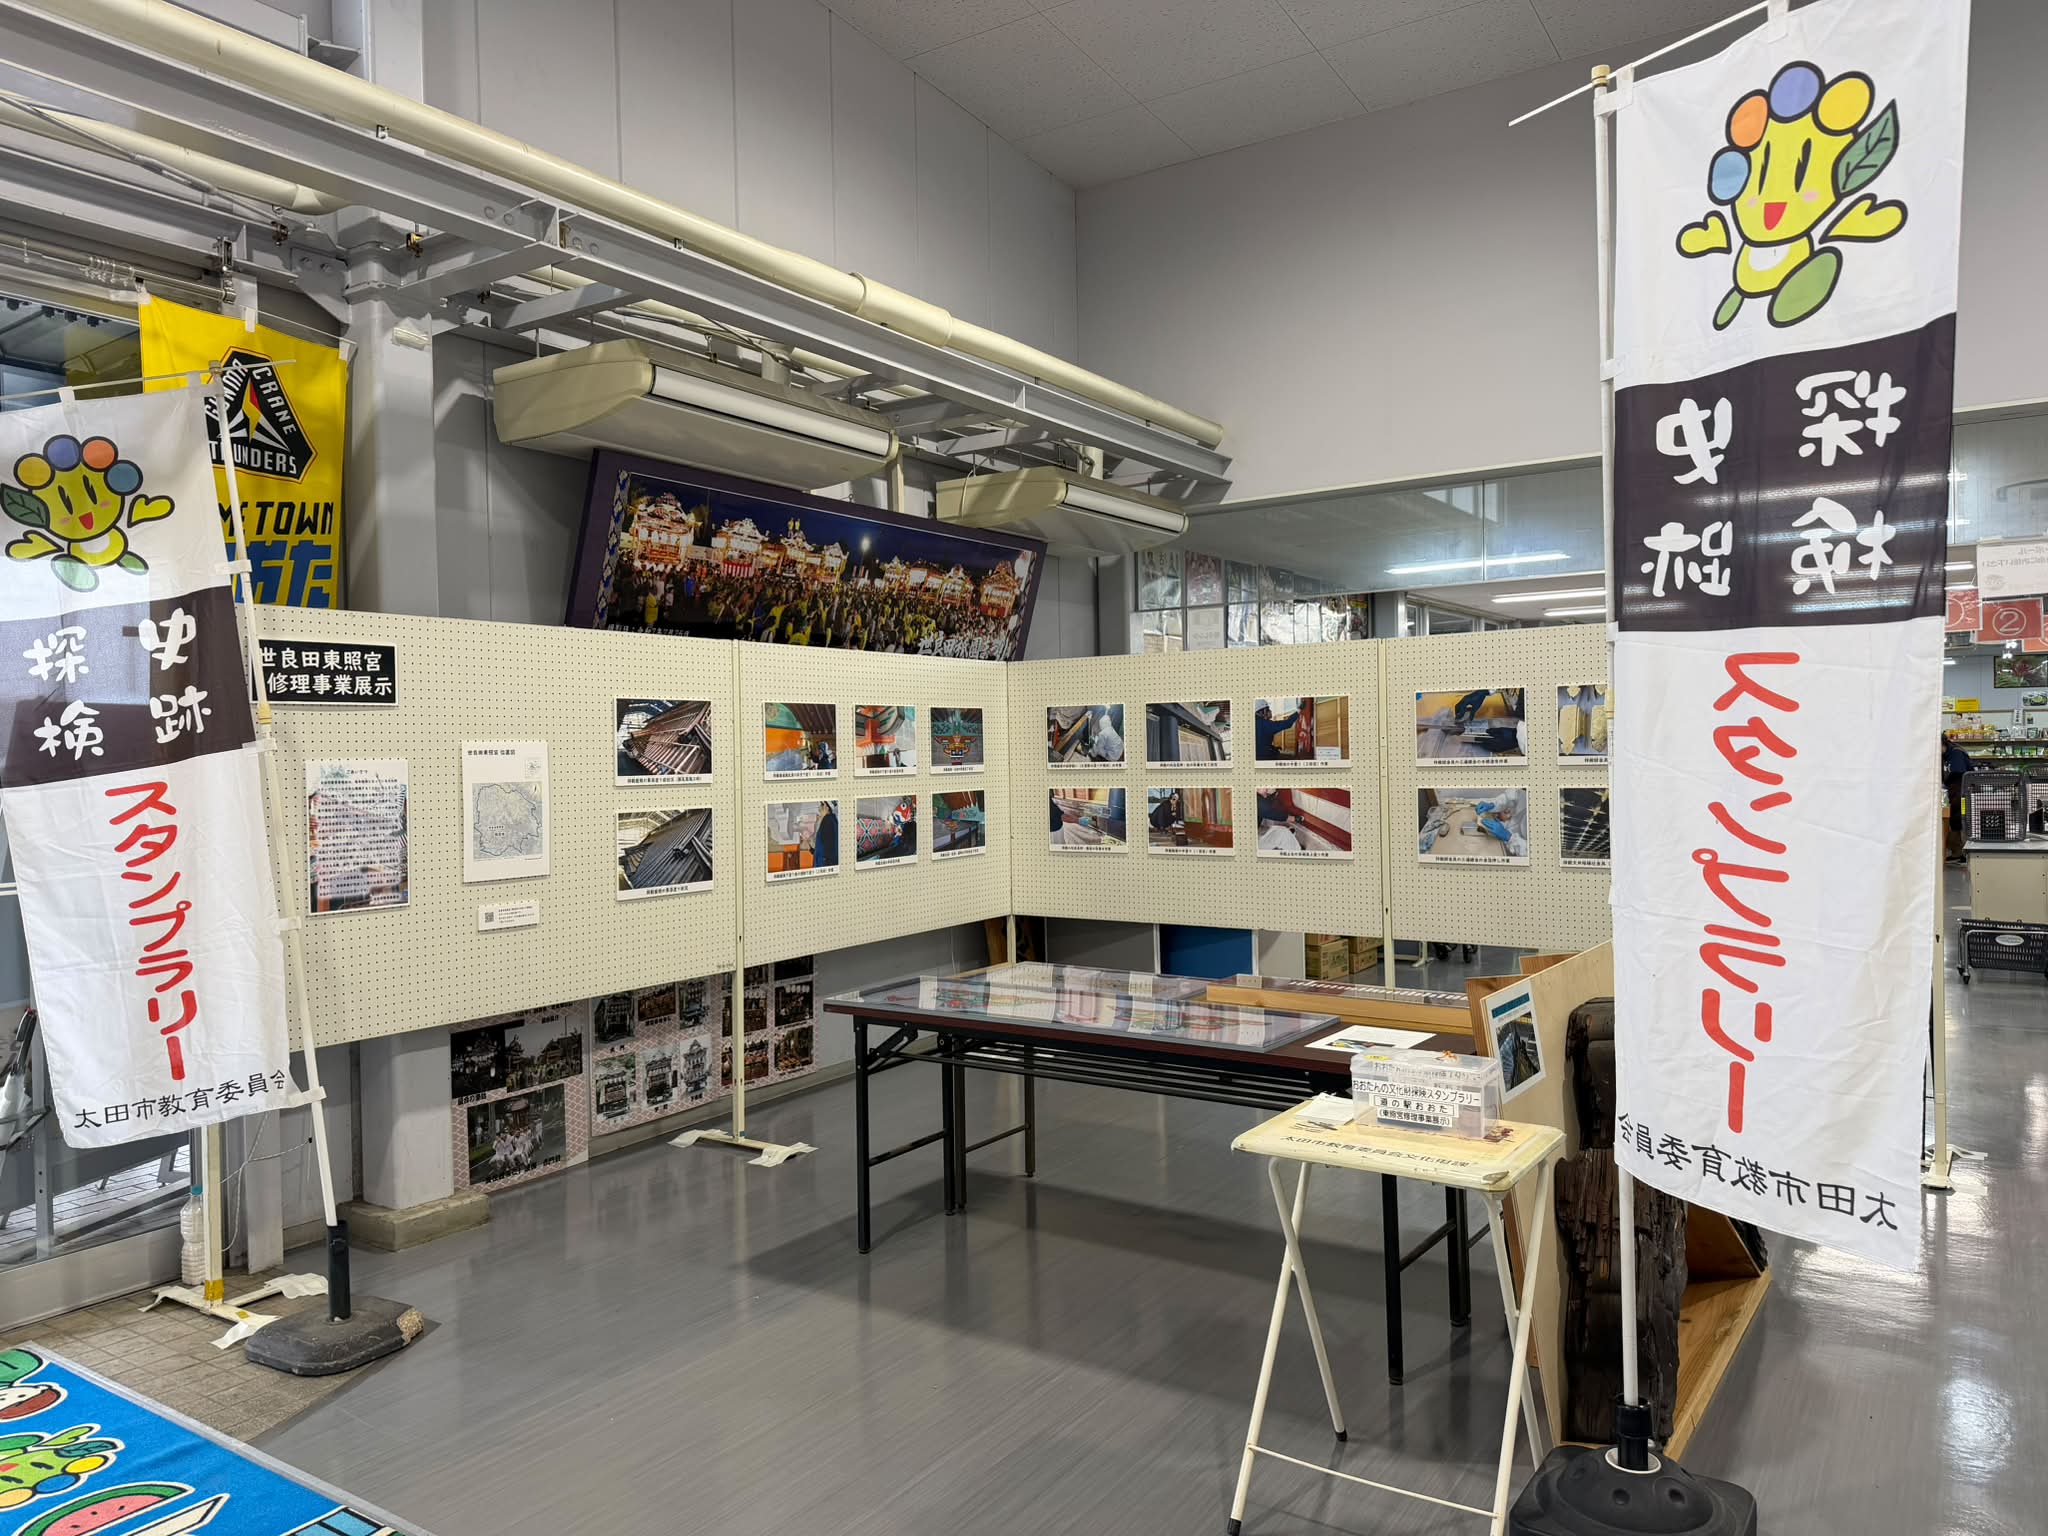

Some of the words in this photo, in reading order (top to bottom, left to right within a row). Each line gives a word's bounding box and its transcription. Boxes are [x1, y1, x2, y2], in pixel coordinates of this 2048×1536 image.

[252, 366, 297, 436] CRANE
[255, 501, 335, 536] TOWN
[260, 646, 382, 672] 世良田東照宮
[266, 672, 393, 696] 修理事業展示
[105, 781, 198, 1081] スタンプラリー
[74, 1069, 286, 1130] 太田市教育委員会
